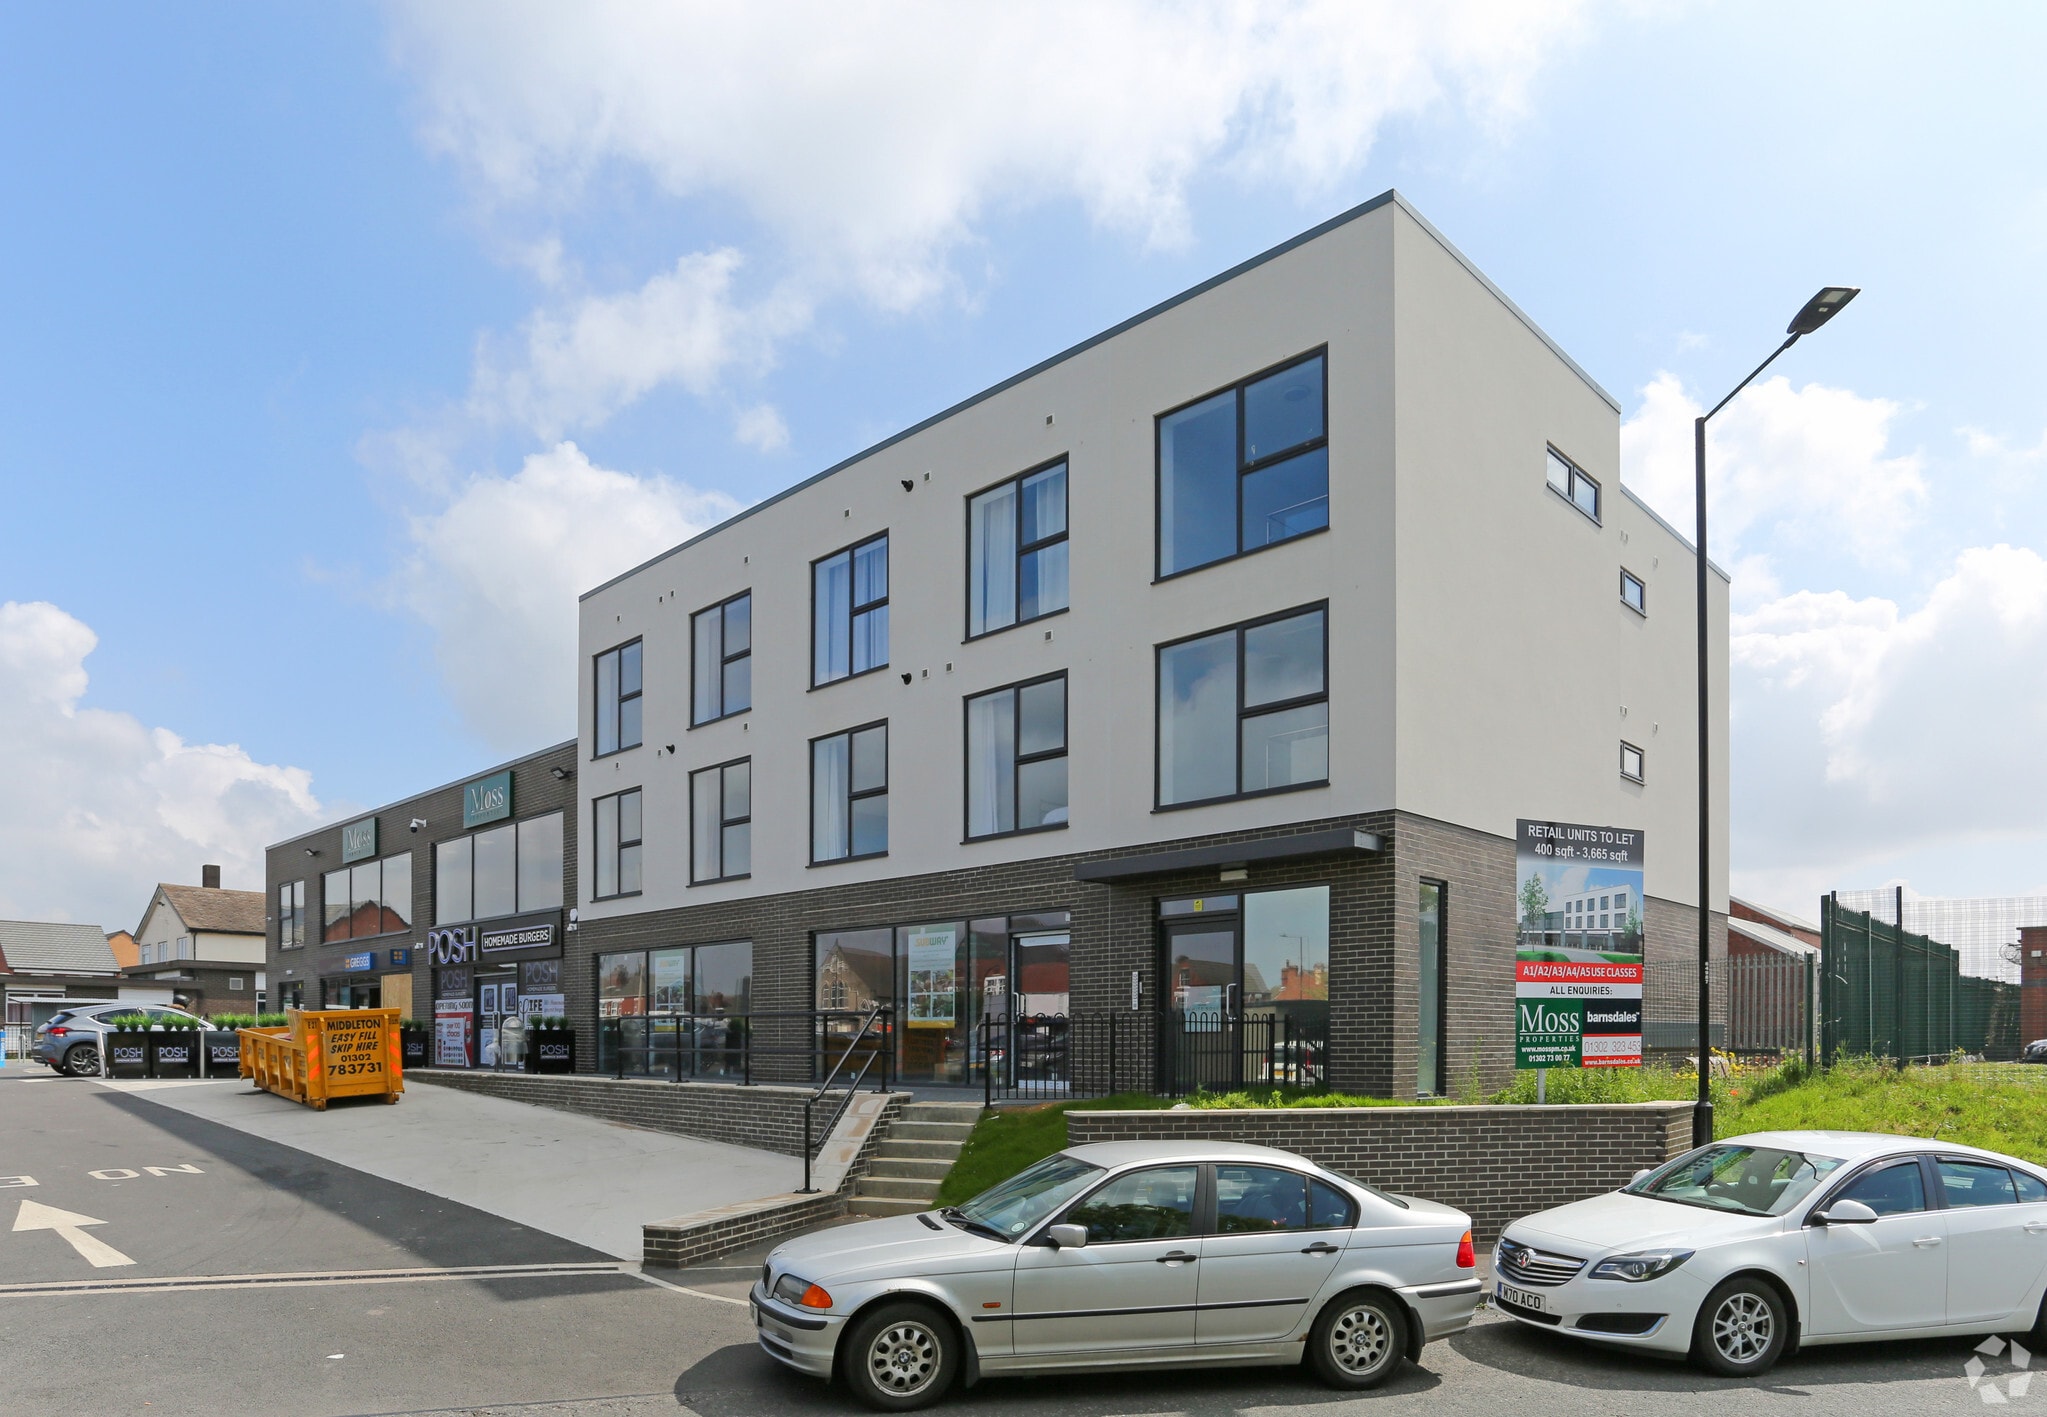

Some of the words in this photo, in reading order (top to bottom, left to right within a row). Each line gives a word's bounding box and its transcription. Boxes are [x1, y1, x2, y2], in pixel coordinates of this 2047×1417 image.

[1528, 825, 1565, 839] RETAIL
[1567, 828, 1598, 842] UNITS
[1599, 831, 1614, 843] TO
[1616, 833, 1635, 845] LET
[1534, 843, 1553, 855] 400
[1555, 845, 1574, 859] sqft
[1582, 847, 1608, 860] 3,665
[1609, 850, 1628, 863] sqft
[484, 934, 518, 947] HOMEMADE
[519, 930, 549, 943] BURGERS
[428, 926, 477, 965] POSH
[350, 956, 370, 968] GREGGS
[525, 960, 558, 983] POSH
[1591, 967, 1605, 977] USE
[1606, 967, 1637, 978] CLASSES
[1550, 986, 1565, 995] ALL
[1567, 986, 1613, 995] ENQUIRIES:
[1587, 1011, 1638, 1023] barnsdales
[326, 1019, 381, 1031] MIDDLETON
[331, 1032, 356, 1043] EASY
[358, 1031, 377, 1041] FILL
[1519, 1035, 1580, 1043] PROPERTIES
[114, 1047, 143, 1058] POSH
[159, 1046, 189, 1058] POSH
[330, 1043, 353, 1054] SKIP
[356, 1041, 379, 1052] HIRE
[407, 1043, 424, 1051] SH
[540, 1044, 569, 1055] POSH
[1584, 1041, 1608, 1053] 01302
[1612, 1041, 1626, 1053] 323
[340, 1053, 371, 1062] 01302
[1528, 1054, 1546, 1062] 01302
[1547, 1054, 1555, 1062] 73
[328, 1062, 382, 1076] 783731
[1520, 1293, 1541, 1309] ACO
